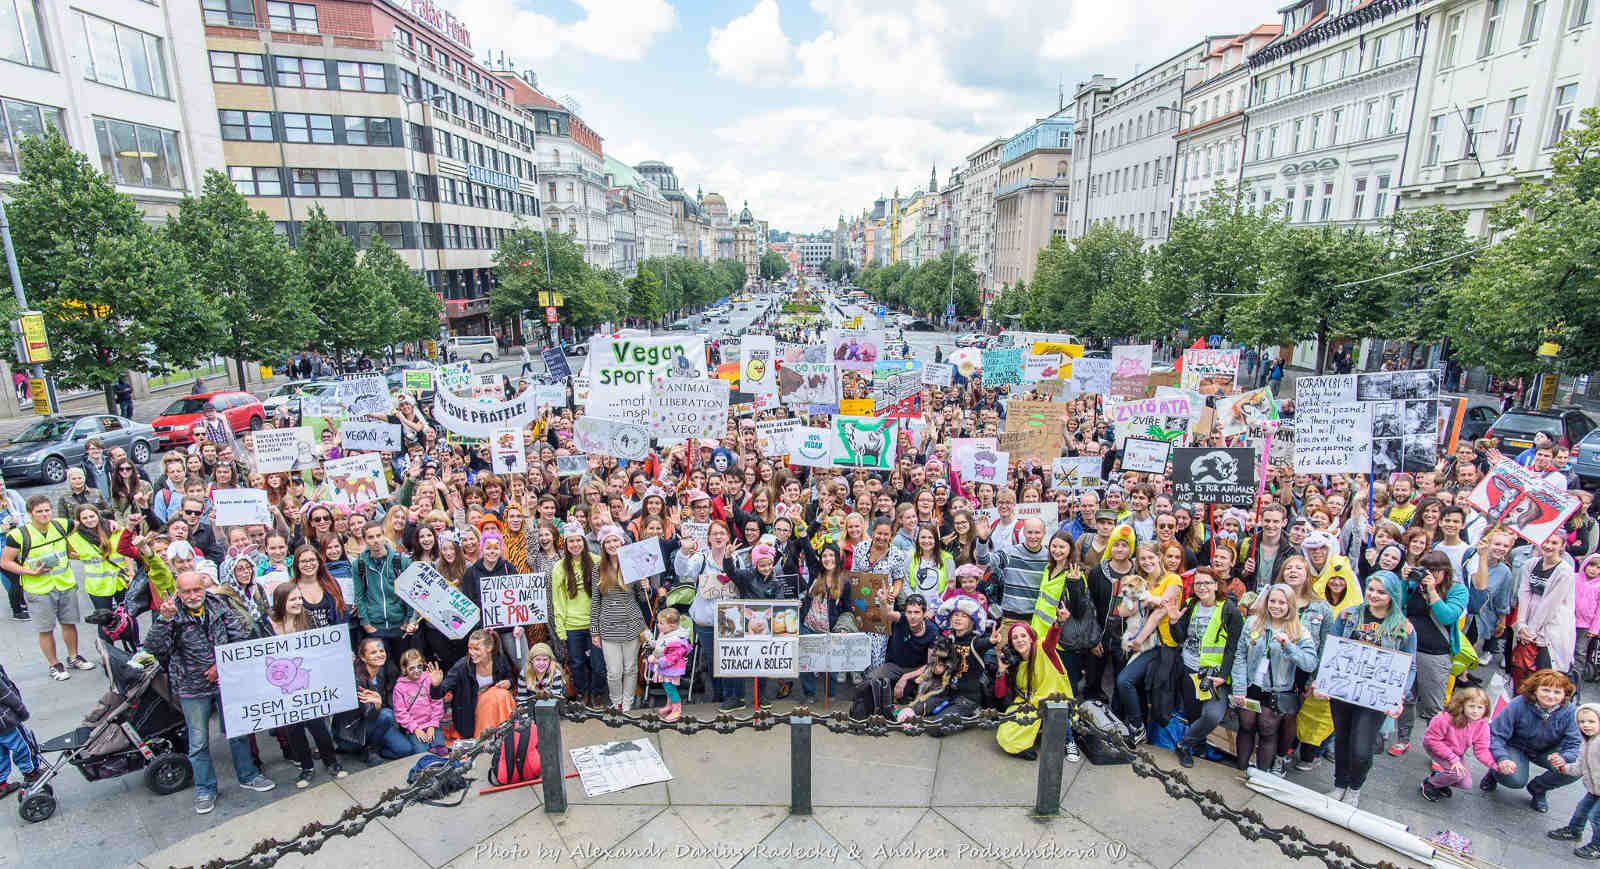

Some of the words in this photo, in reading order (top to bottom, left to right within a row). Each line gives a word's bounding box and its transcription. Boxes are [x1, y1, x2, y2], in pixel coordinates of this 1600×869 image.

[666, 383, 712, 393] ANIMAL
[659, 398, 723, 409] LIBERATION
[677, 413, 697, 422] GO
[345, 429, 378, 442] VEGAN
[1175, 483, 1191, 491] FUR
[1177, 492, 1194, 502] NOT
[1222, 495, 1254, 504] IDIOTS
[482, 591, 498, 603] TU
[502, 589, 516, 606] S
[484, 605, 504, 625] NE
[507, 604, 529, 624] PRO
[220, 639, 289, 664] NEJSEM
[295, 630, 341, 650] JÍDLO
[720, 645, 749, 657] TAKY
[720, 657, 753, 670] STRACH
[755, 658, 764, 669] A
[764, 657, 793, 670] BOLEST
[241, 699, 284, 719] JSEM
[292, 685, 339, 707] SIDÍK
[251, 718, 263, 732] Z
[271, 703, 331, 726] TIBETU
